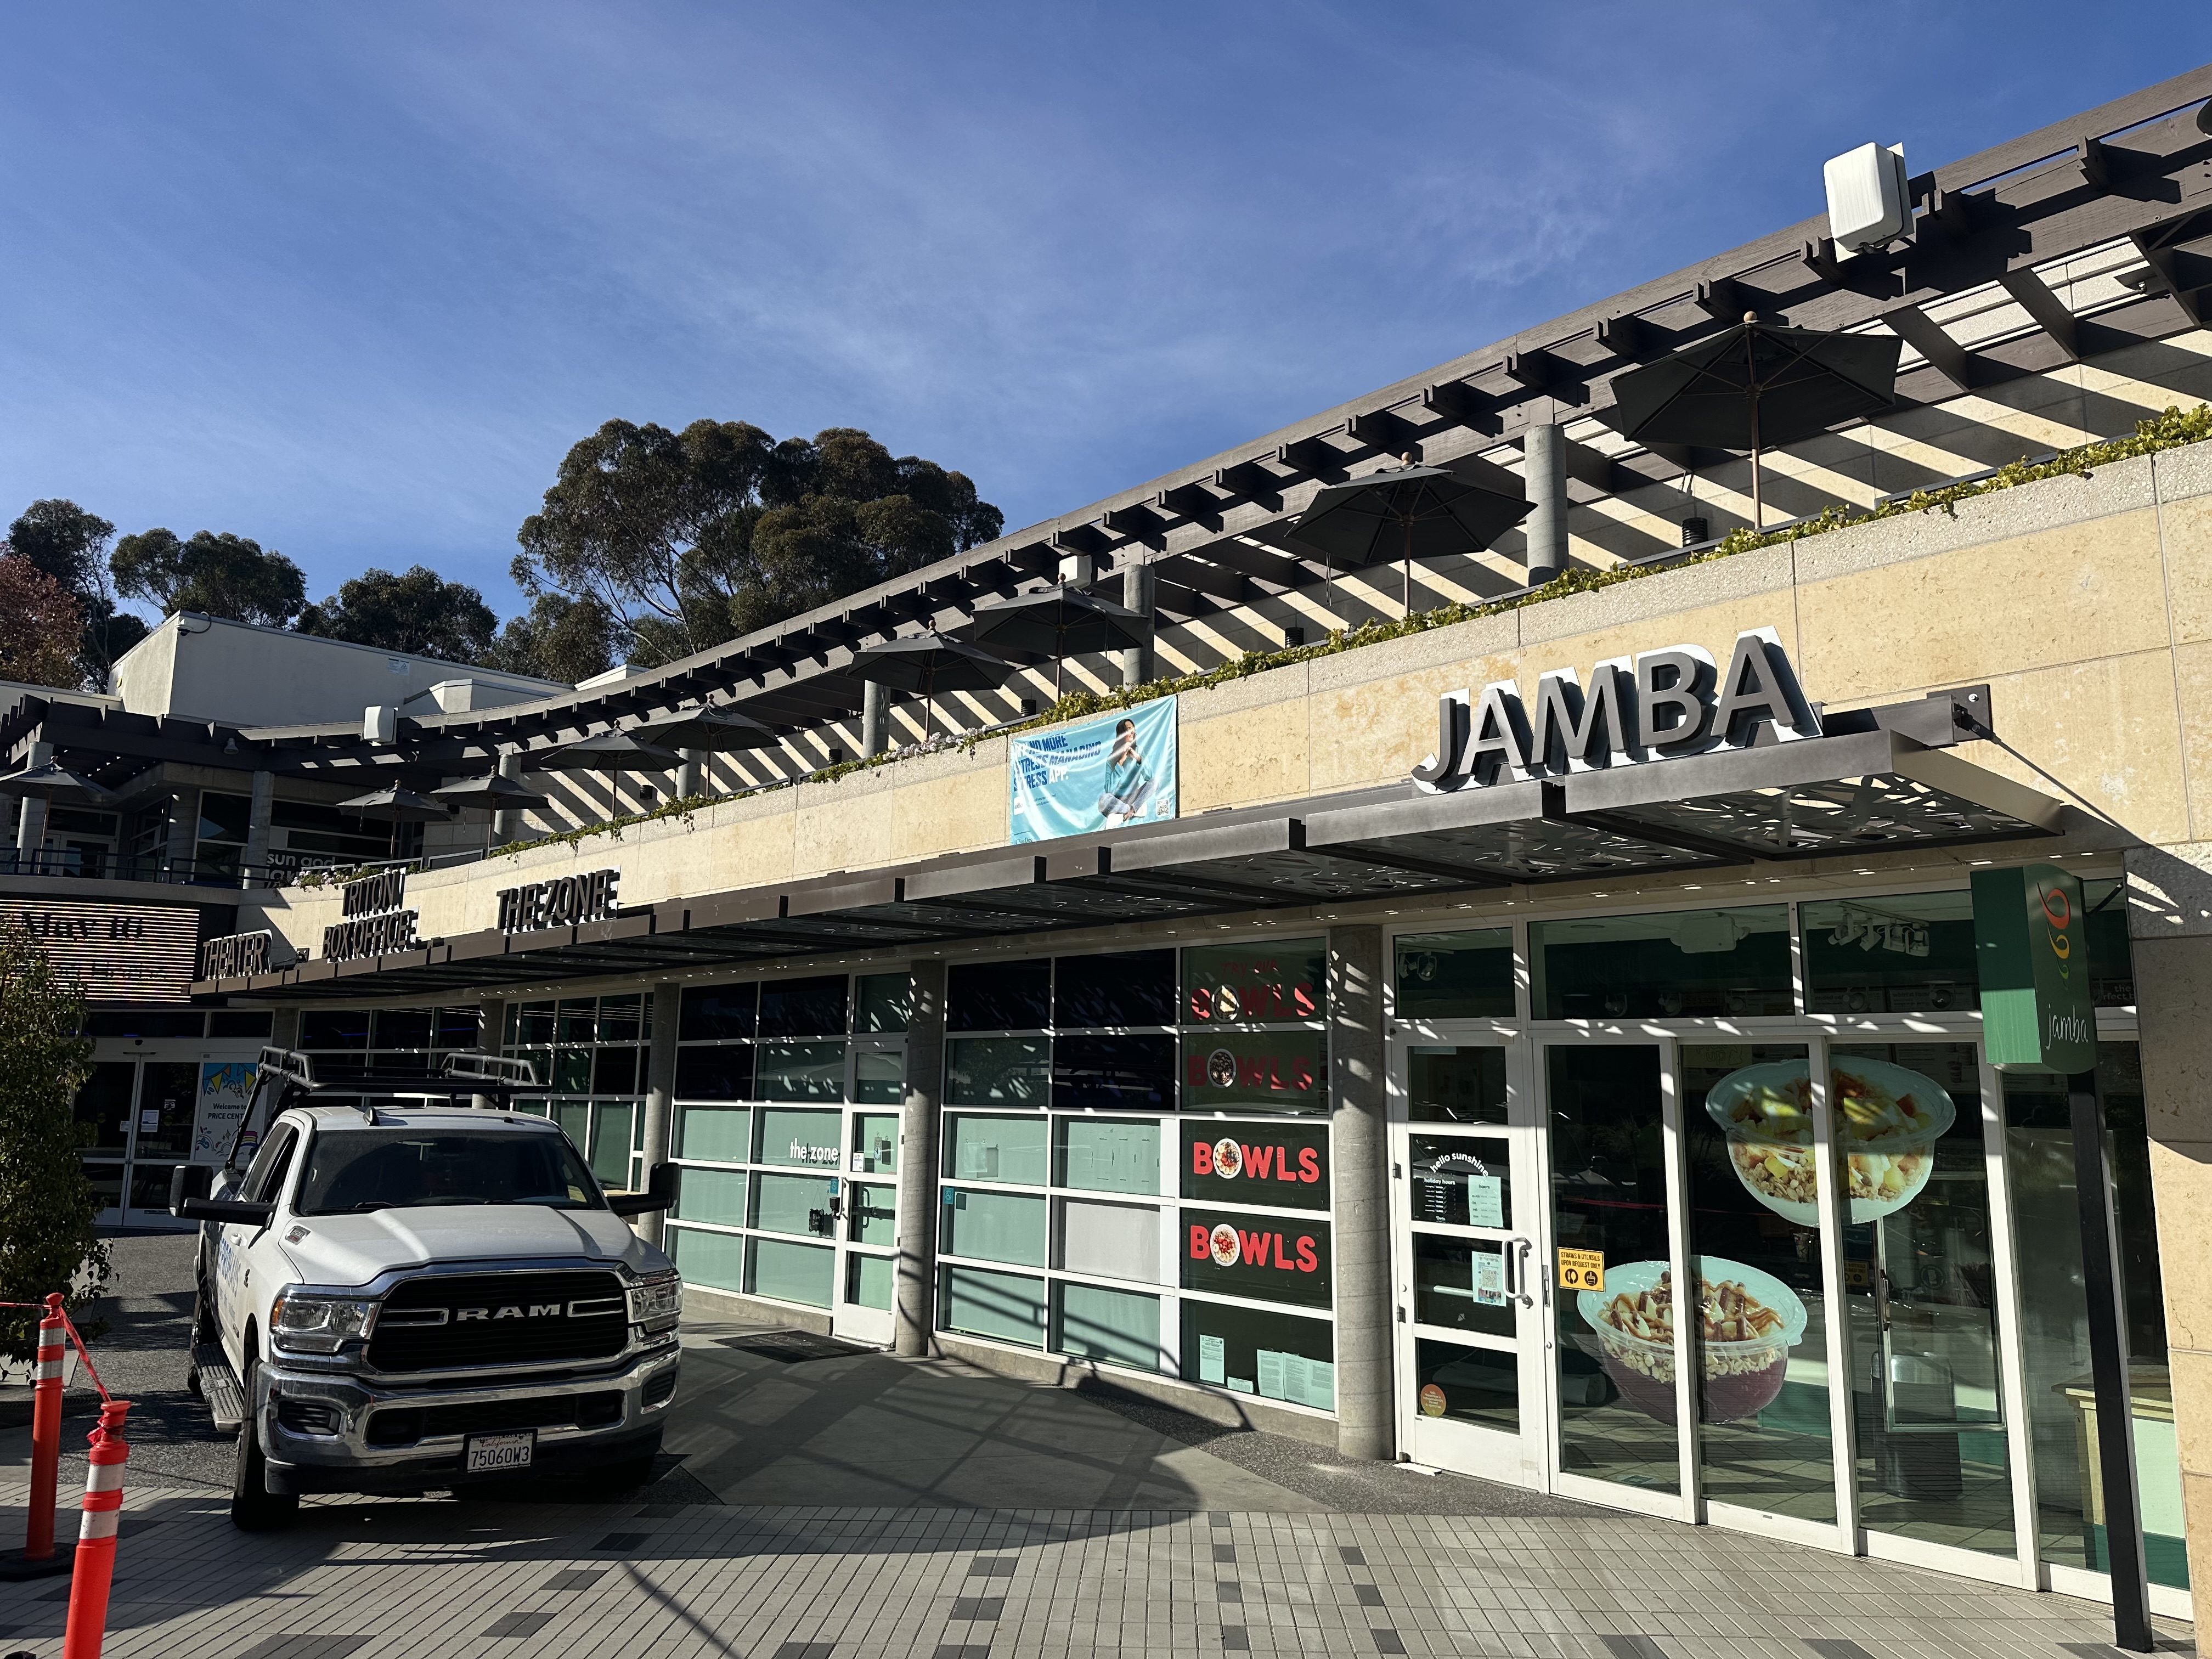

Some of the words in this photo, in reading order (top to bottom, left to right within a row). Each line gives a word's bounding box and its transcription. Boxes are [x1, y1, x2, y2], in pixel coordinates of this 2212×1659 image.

[1411, 634, 1798, 783] JAMBA
[1042, 732, 1068, 752] MORE
[267, 853, 296, 867] sun
[342, 871, 403, 916] TRITON
[496, 884, 541, 930] THE
[541, 868, 614, 922] ZONE
[203, 933, 268, 978] THEATER
[323, 922, 354, 959] BOX
[354, 911, 409, 952] OFFICE
[1192, 981, 1316, 1023] BOWLS
[2045, 1003, 2089, 1050] jamba
[1188, 1048, 1313, 1092] BOWLS
[790, 1137, 807, 1159] the
[810, 1145, 839, 1161] zone
[1193, 1138, 1321, 1183] BOWLS
[1430, 1154, 1451, 1173] hello
[1451, 1153, 1489, 1178] sunshine
[1189, 1223, 1318, 1273] BOWLS
[456, 1304, 561, 1321] RAM
[471, 1446, 529, 1468] 75060W3
[481, 1438, 522, 1449] California
